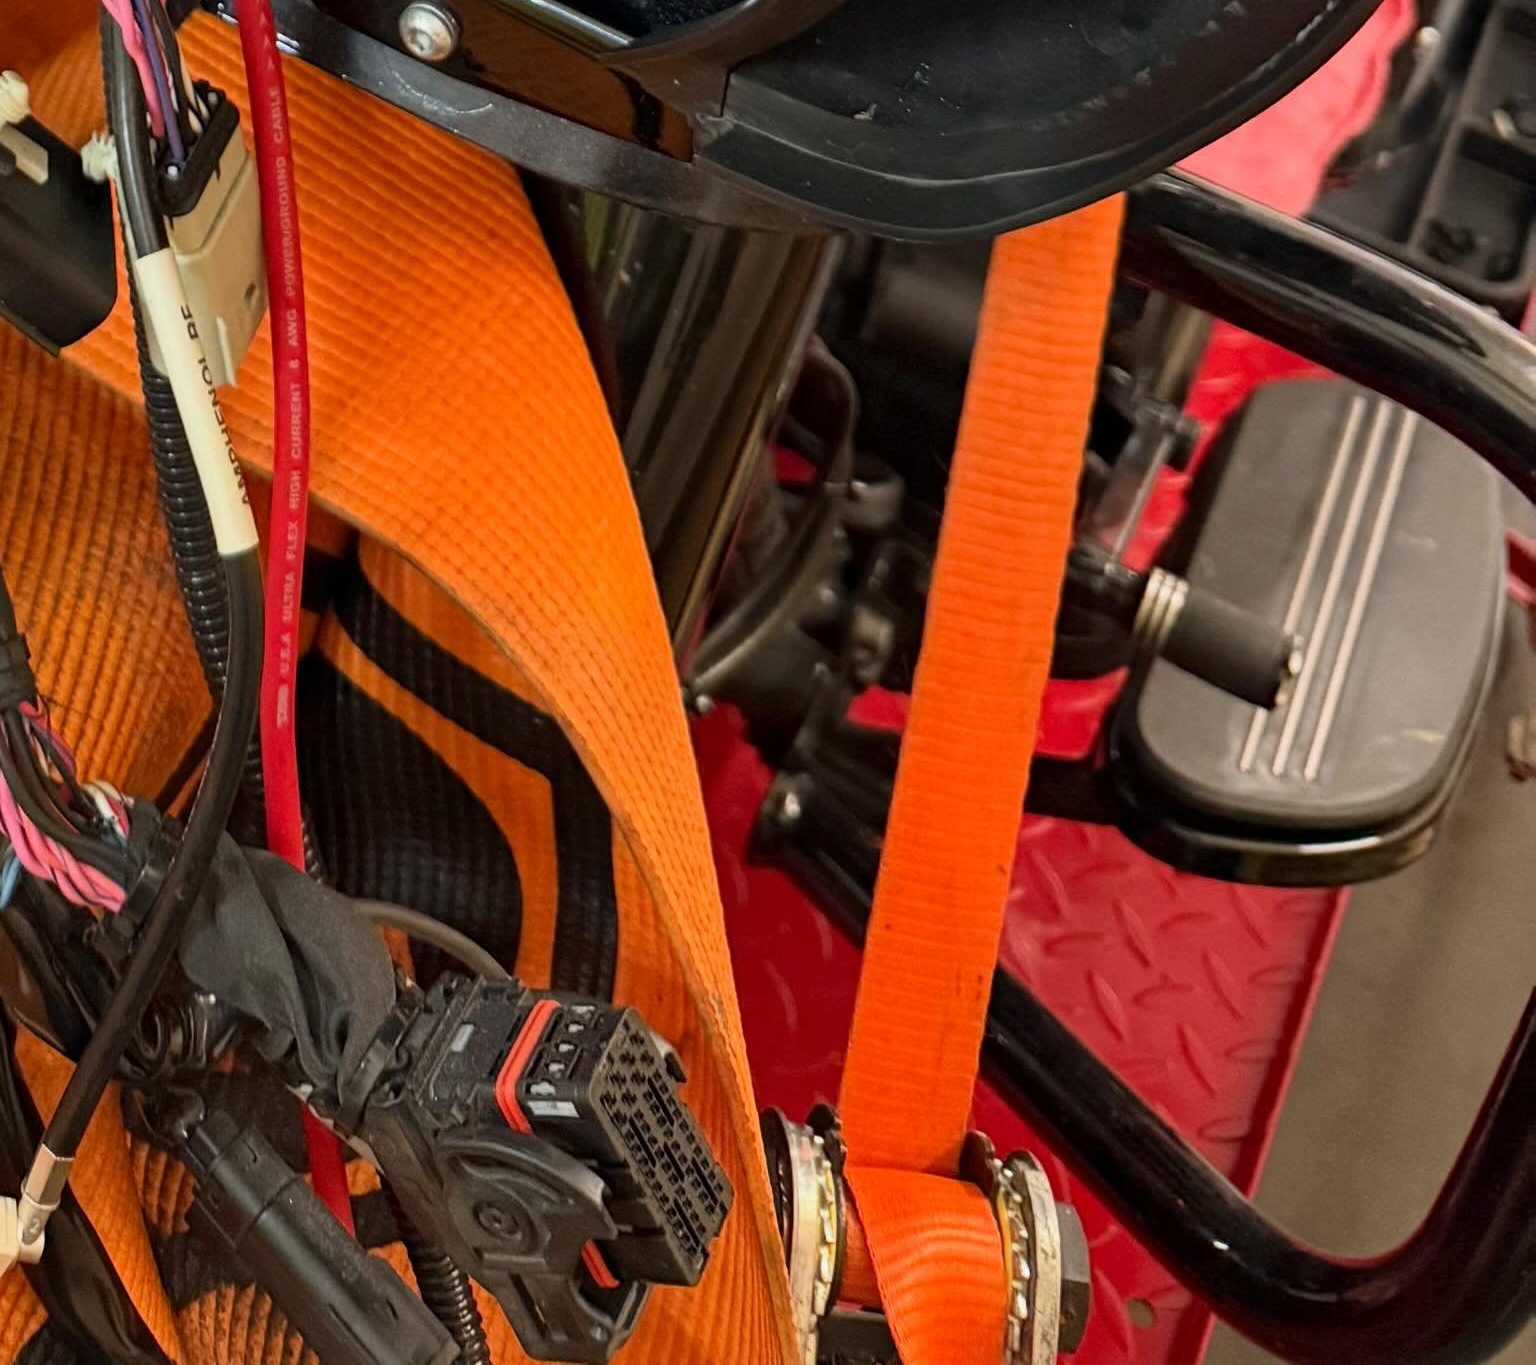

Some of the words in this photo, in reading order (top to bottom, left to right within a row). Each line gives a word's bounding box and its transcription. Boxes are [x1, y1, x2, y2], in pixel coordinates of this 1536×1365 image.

[268, 85, 284, 144] CABLE
[274, 156, 295, 297] POWER/GROUND
[287, 309, 299, 348] AWG
[289, 380, 301, 460] CURRENT
[288, 470, 301, 510] HIGH
[285, 520, 299, 560] FLEX
[282, 571, 295, 621] ULTRA
